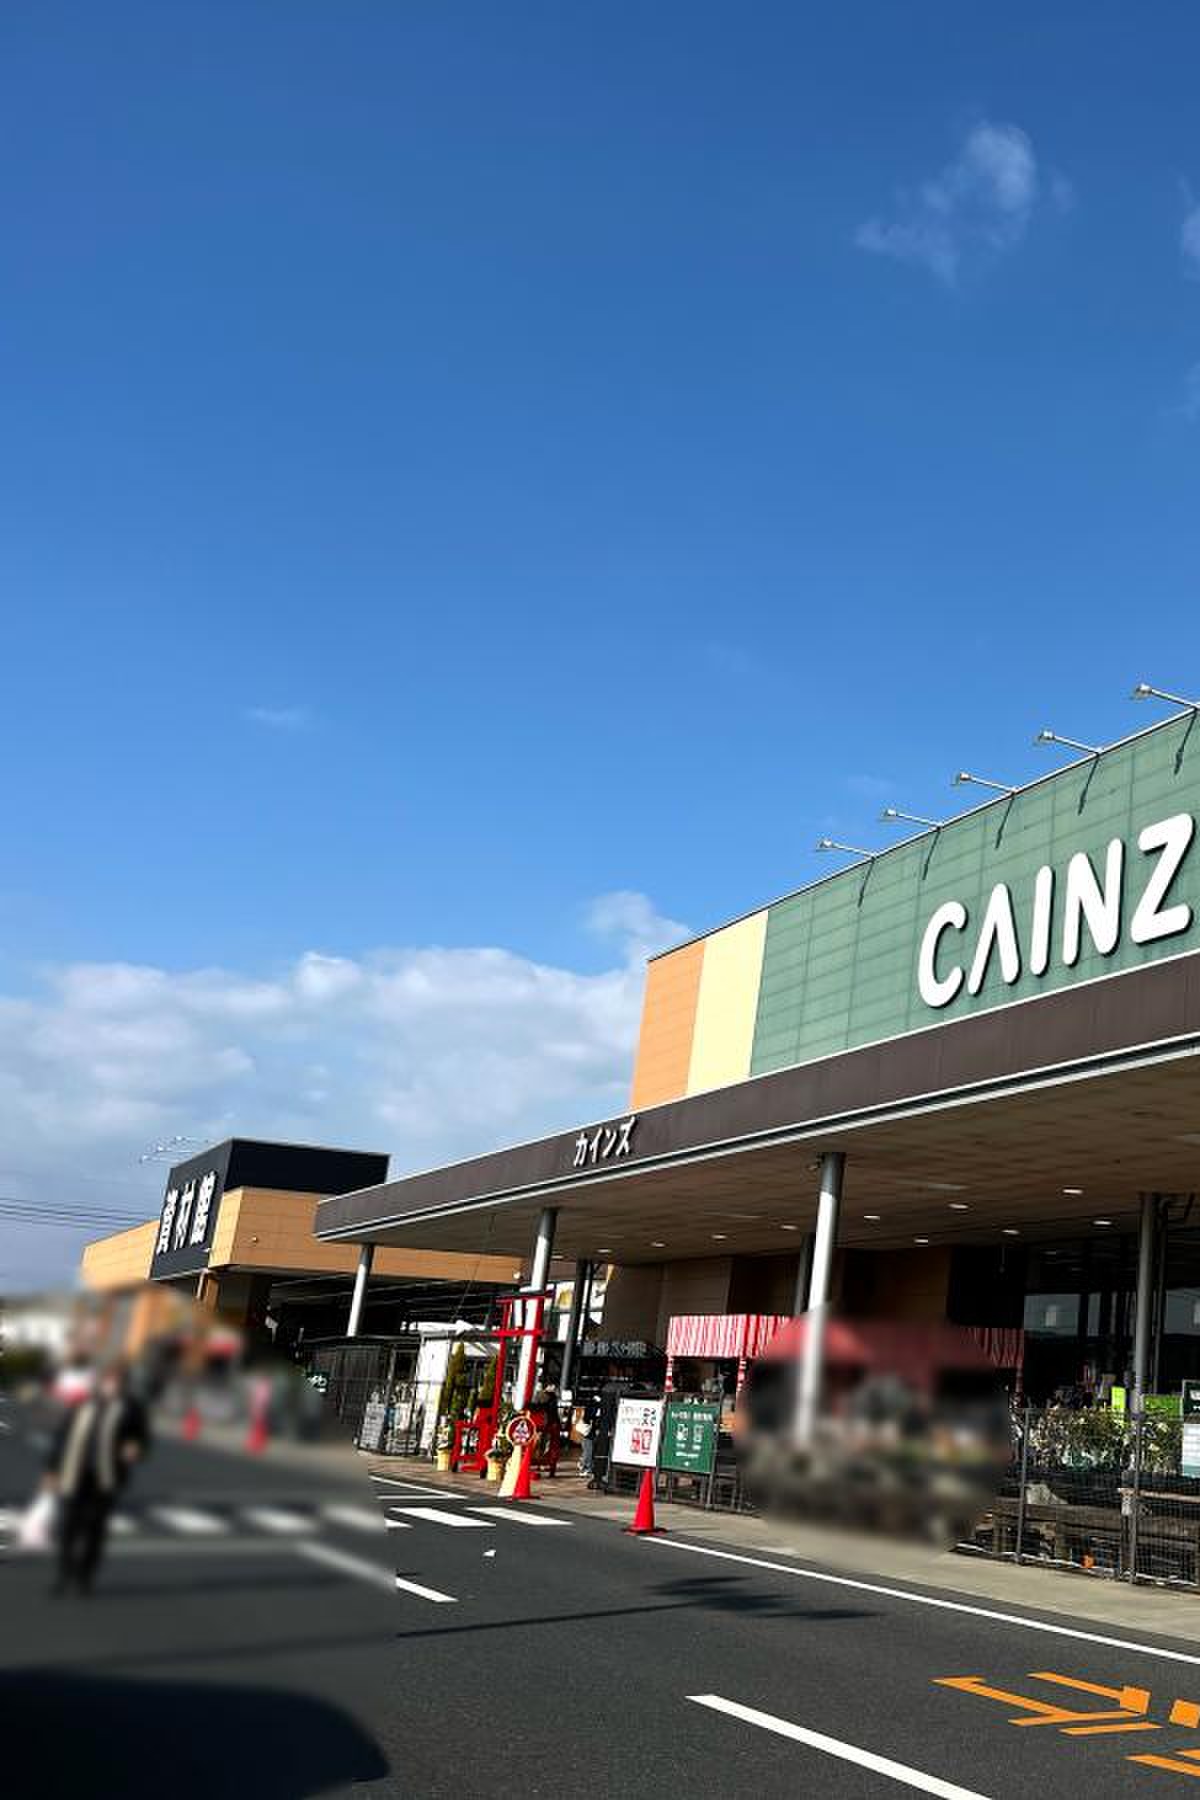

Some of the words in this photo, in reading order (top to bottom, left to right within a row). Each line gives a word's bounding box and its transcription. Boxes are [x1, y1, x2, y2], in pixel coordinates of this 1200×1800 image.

[918, 813, 1195, 1009] CAINZ
[573, 1116, 635, 1168] カインズ
